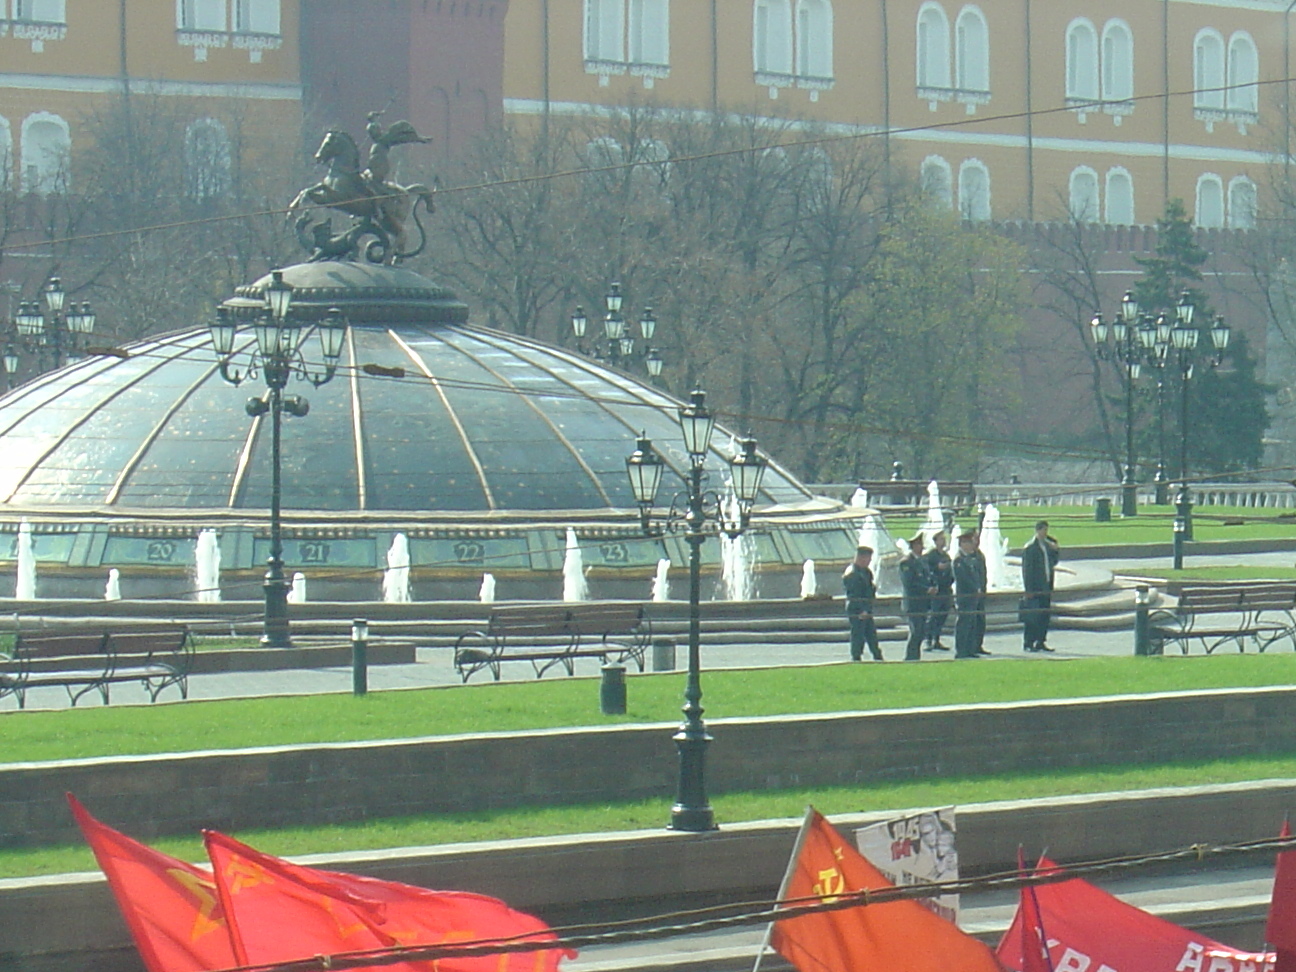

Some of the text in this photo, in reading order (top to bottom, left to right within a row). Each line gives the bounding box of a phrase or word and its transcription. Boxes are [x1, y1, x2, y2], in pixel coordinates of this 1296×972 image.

[150, 543, 172, 559] 20
[306, 543, 323, 561] 21
[458, 543, 478, 561] 22
[605, 543, 624, 560] 23
